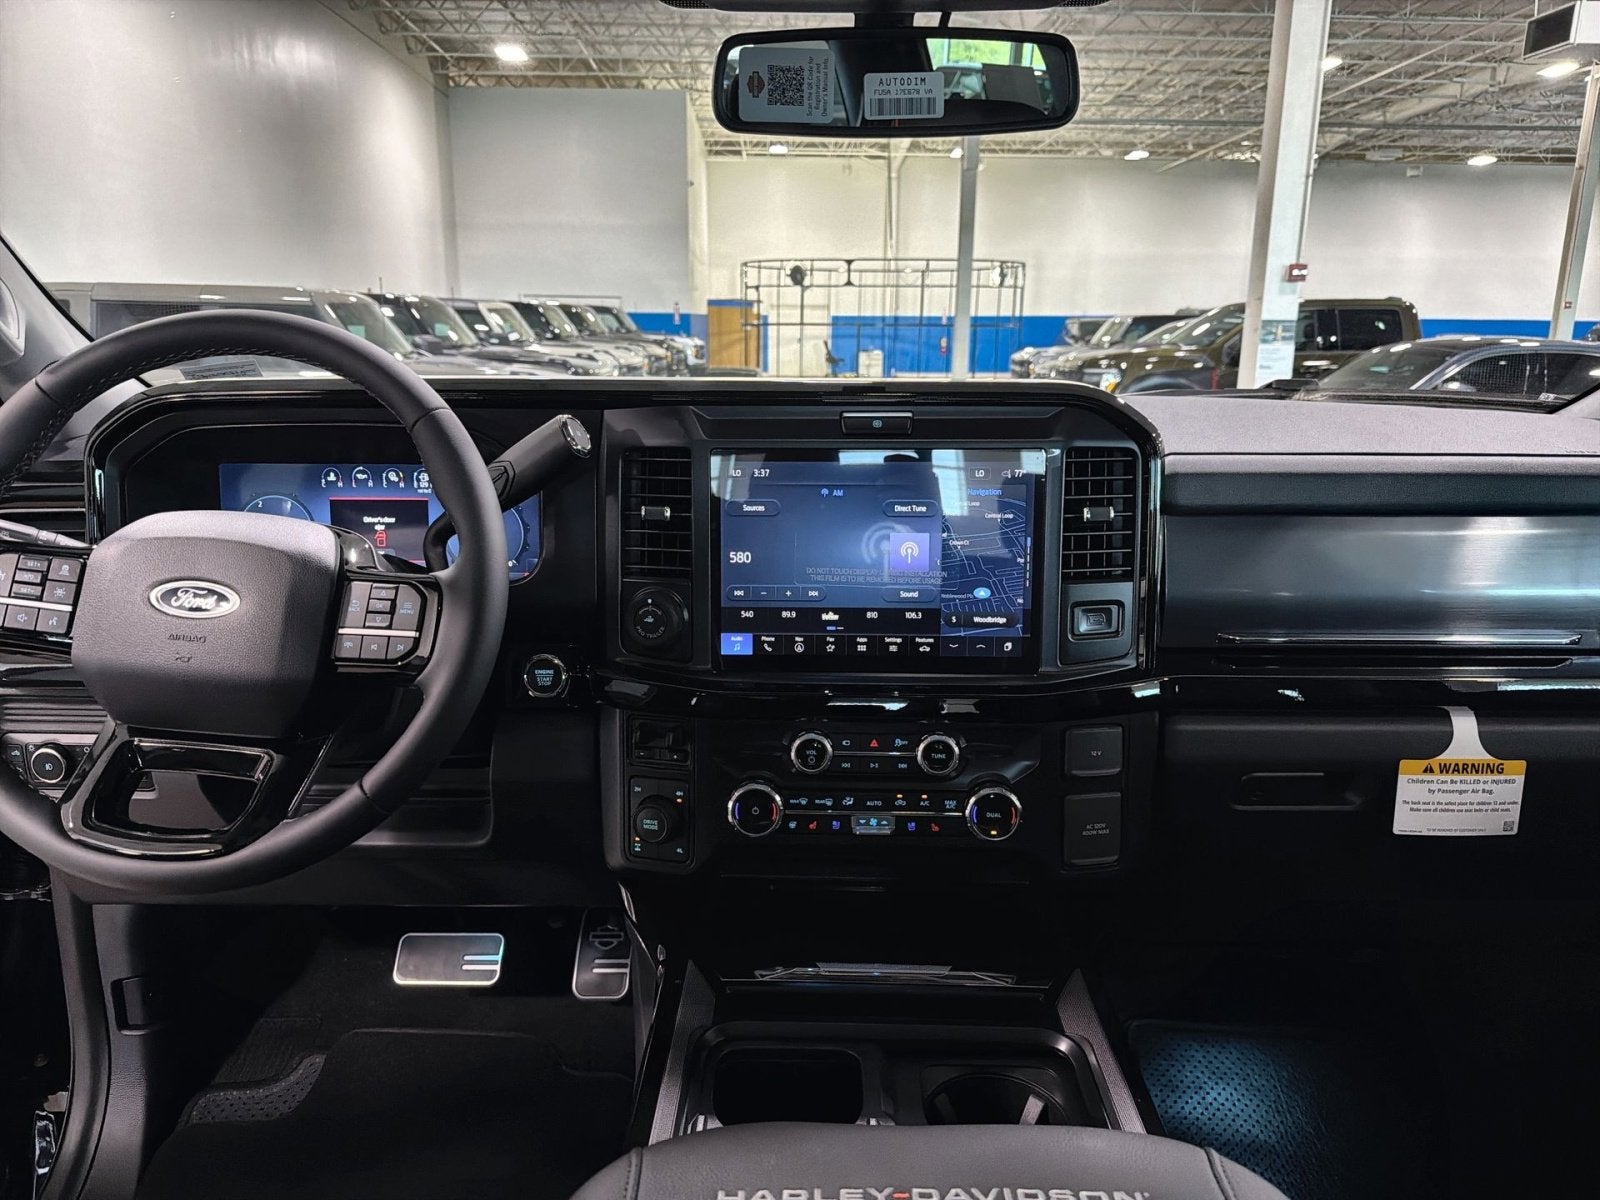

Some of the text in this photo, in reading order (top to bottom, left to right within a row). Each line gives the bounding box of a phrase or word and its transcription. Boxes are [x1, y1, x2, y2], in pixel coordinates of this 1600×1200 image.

[807, 81, 814, 91] QR
[878, 77, 926, 86] AUTODIM
[754, 469, 770, 477] 3:37
[968, 488, 1002, 496] Navigation
[729, 552, 752, 563] 580
[171, 588, 218, 610] Ford
[168, 633, 206, 643] AIRBAG
[1438, 762, 1504, 774] WARNING
[717, 1187, 1146, 1200] HARLEY-DAVIDSON
